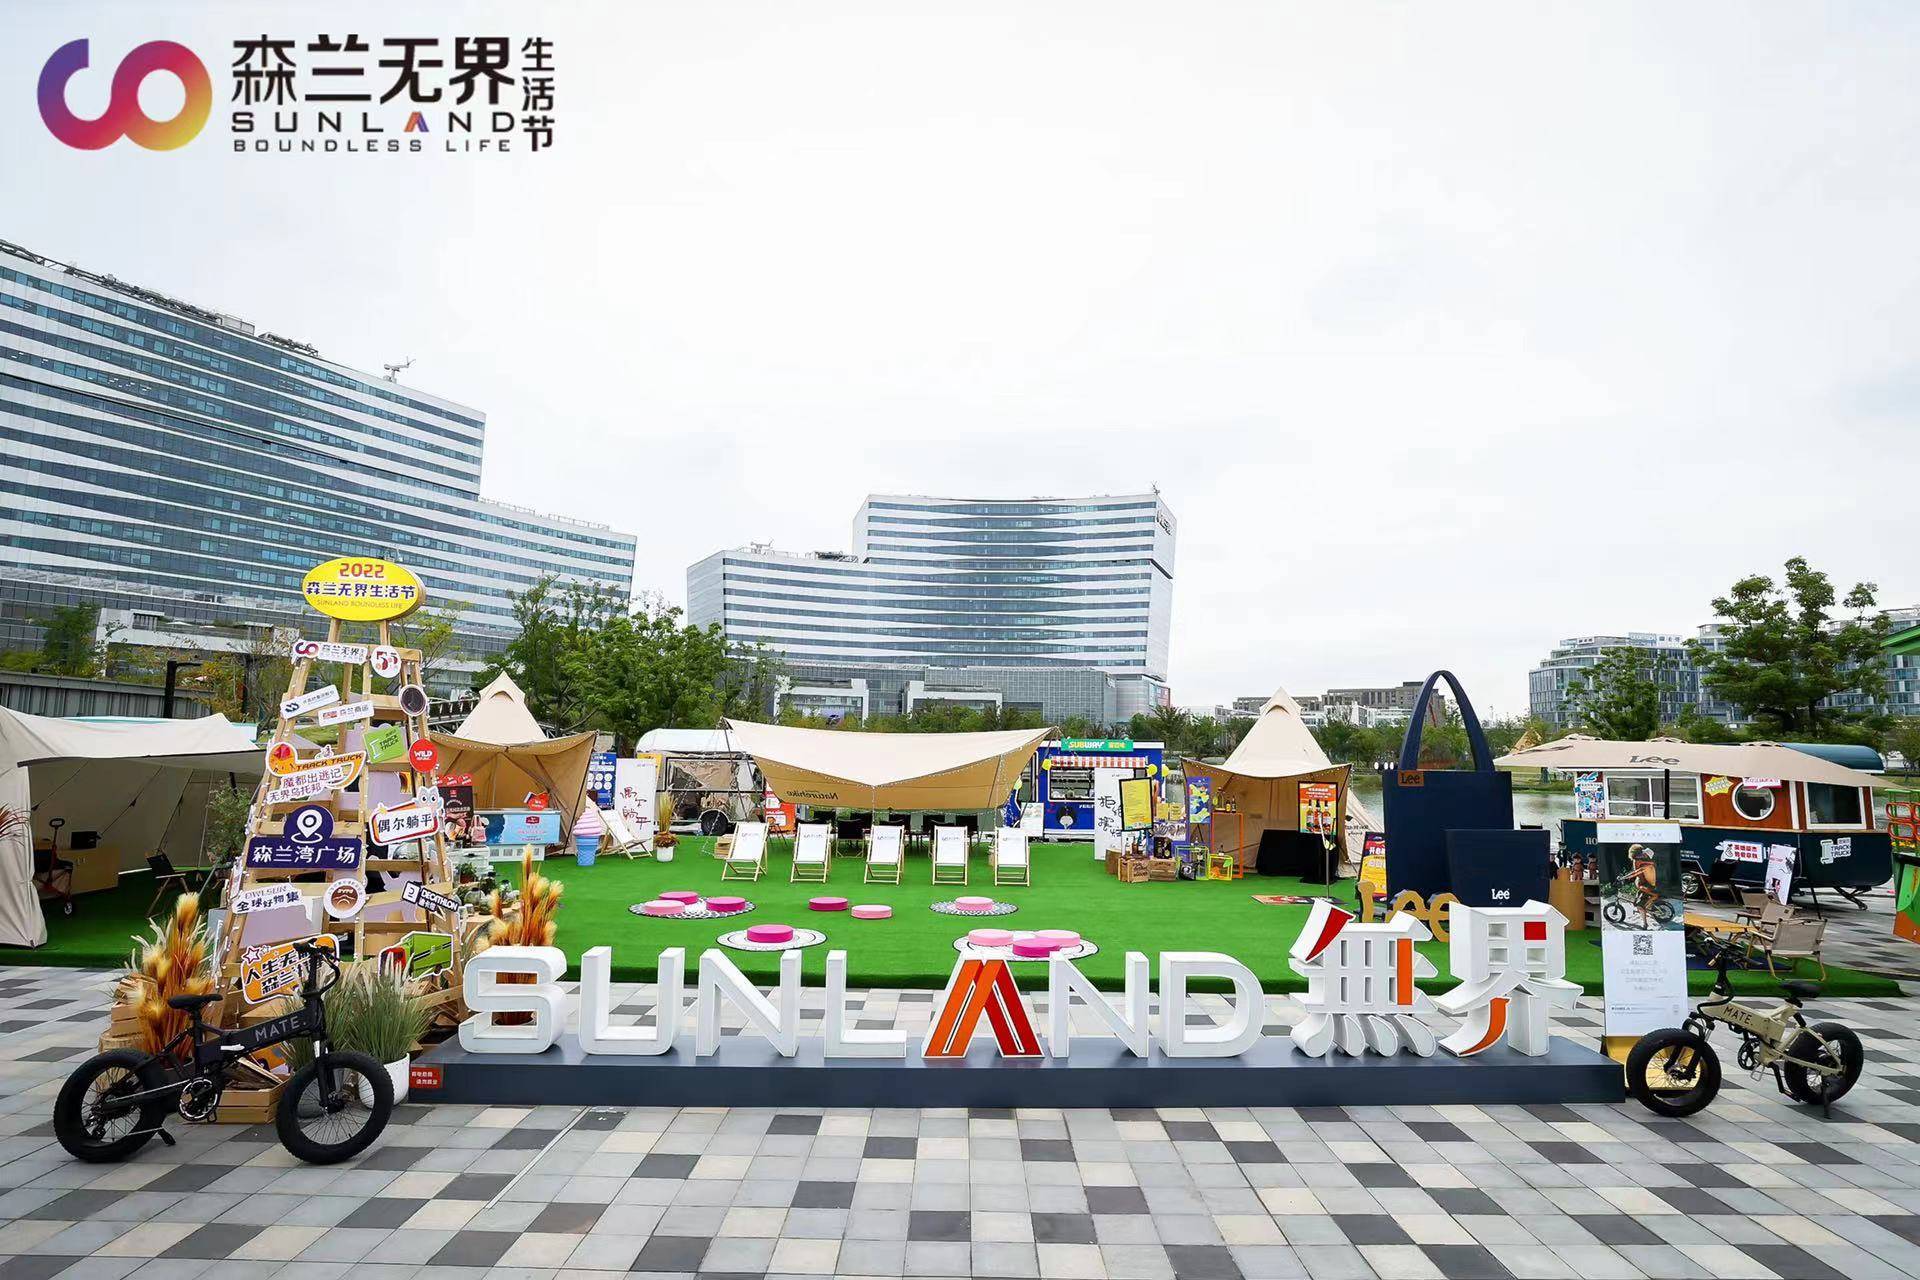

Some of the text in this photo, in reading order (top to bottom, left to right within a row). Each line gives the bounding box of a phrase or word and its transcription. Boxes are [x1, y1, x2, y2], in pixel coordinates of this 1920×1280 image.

[339, 562, 385, 578] 2022
[306, 581, 416, 600] 森兰无界生活节
[1069, 741, 1104, 749] SUBWAY
[329, 754, 364, 765] TRUCK
[413, 750, 433, 758] WILD
[1630, 755, 1680, 765] Lee
[283, 768, 343, 788] 魔都出逃记
[1400, 773, 1420, 785] Lee
[378, 814, 433, 834] 偶尔躺平
[252, 845, 356, 865] 森兰湾广场
[1831, 844, 1850, 852] TRACK
[236, 891, 299, 913] 全球好物集
[420, 888, 459, 912] DECATHLON
[1491, 888, 1510, 900] Lee
[458, 899, 1585, 1060] SUNLAND 無界
